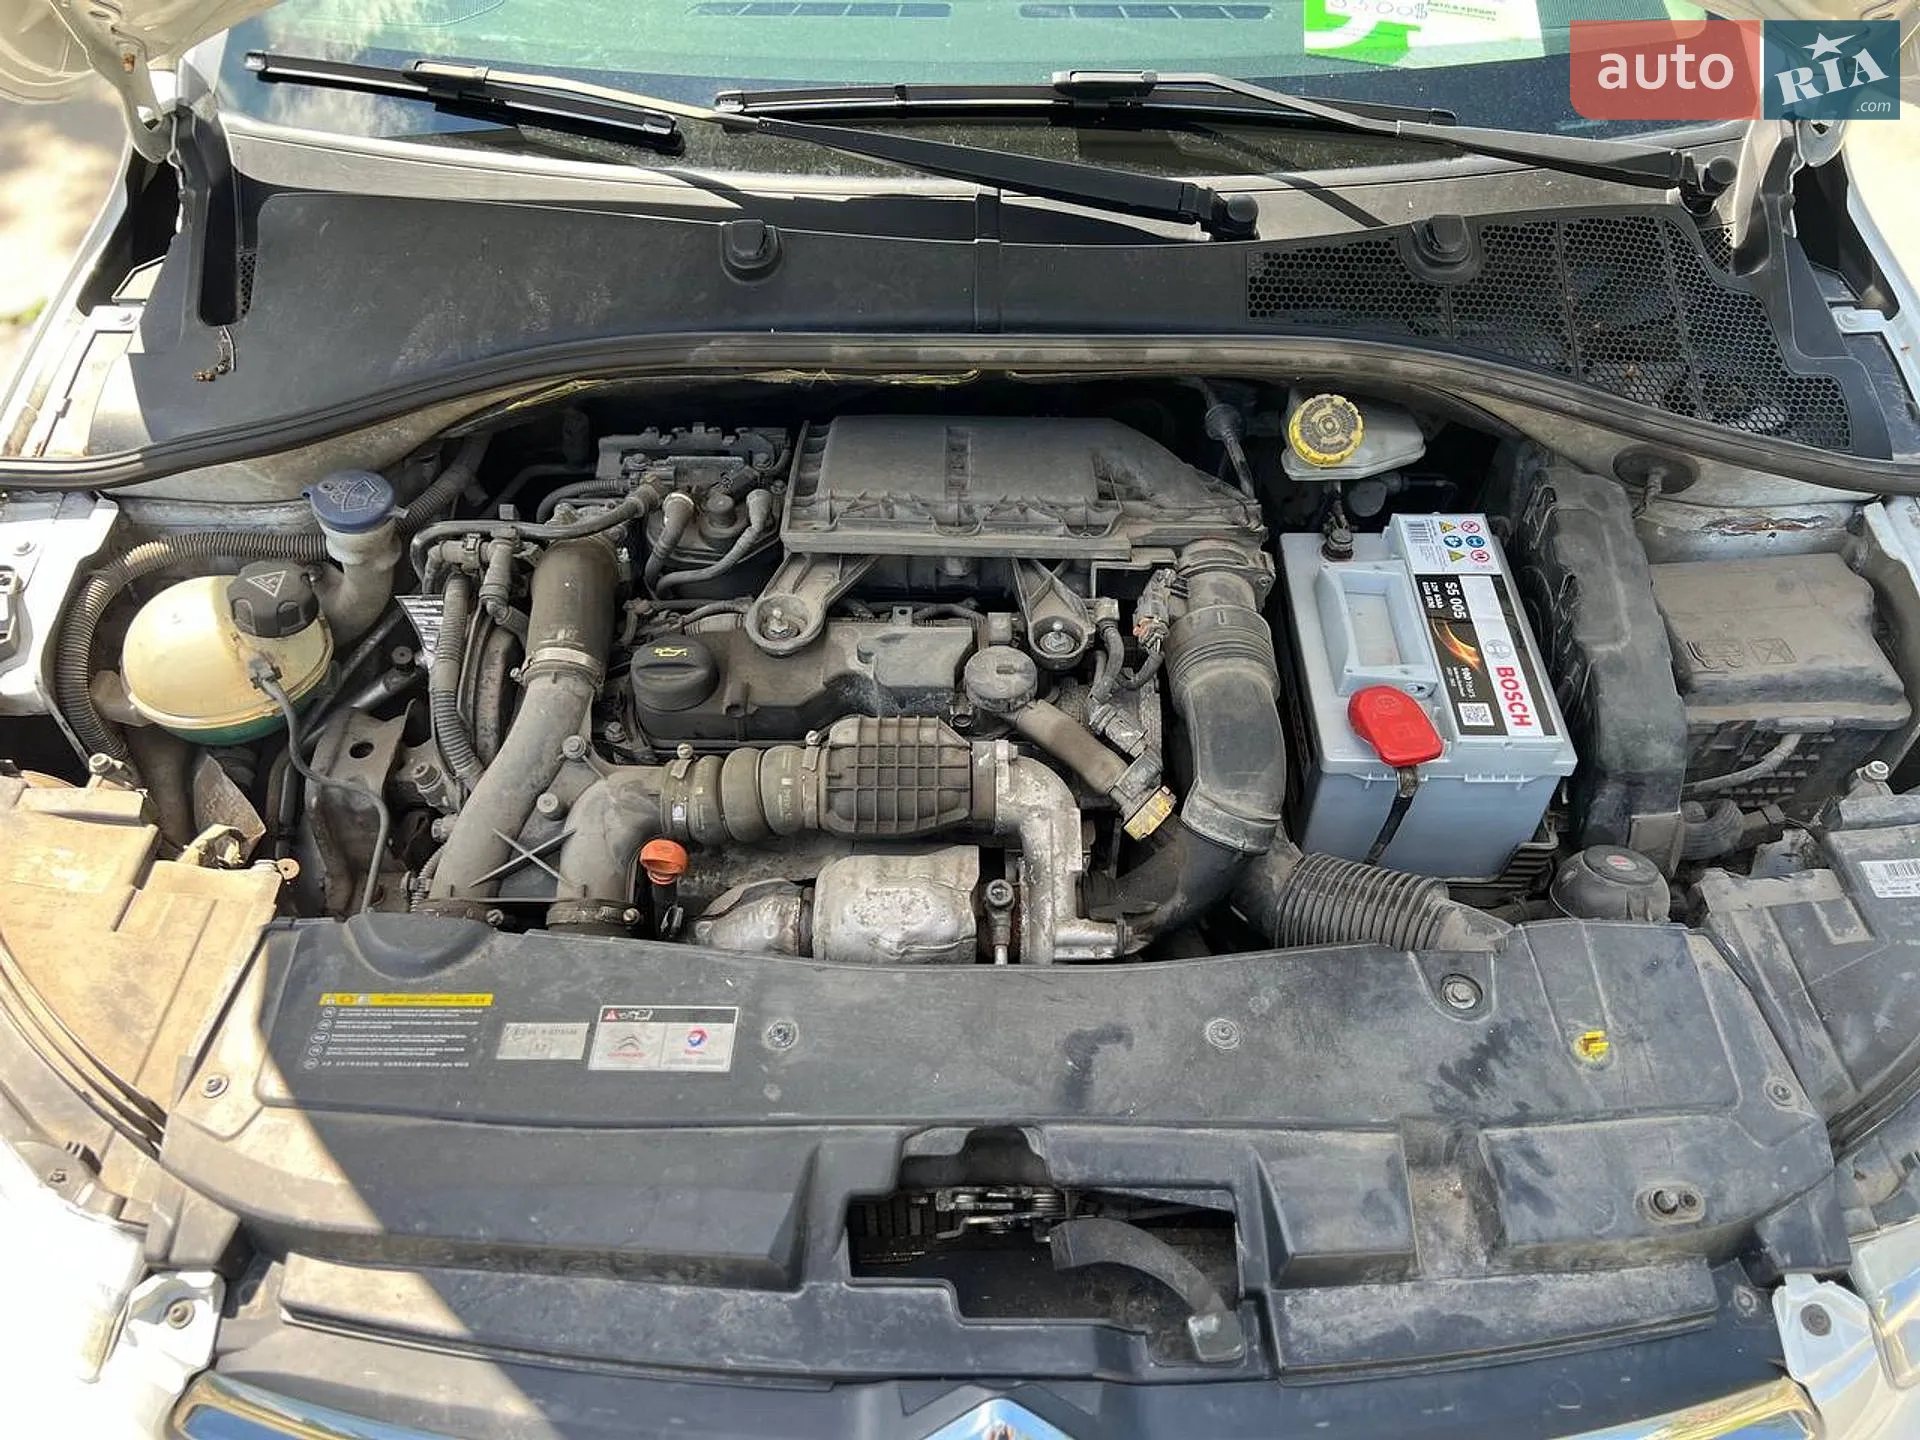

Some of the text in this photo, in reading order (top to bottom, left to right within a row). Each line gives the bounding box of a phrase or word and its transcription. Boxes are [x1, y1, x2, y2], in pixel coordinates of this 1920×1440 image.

[1445, 581, 1467, 619] S5 005
[1496, 666, 1532, 726] BOSCH
